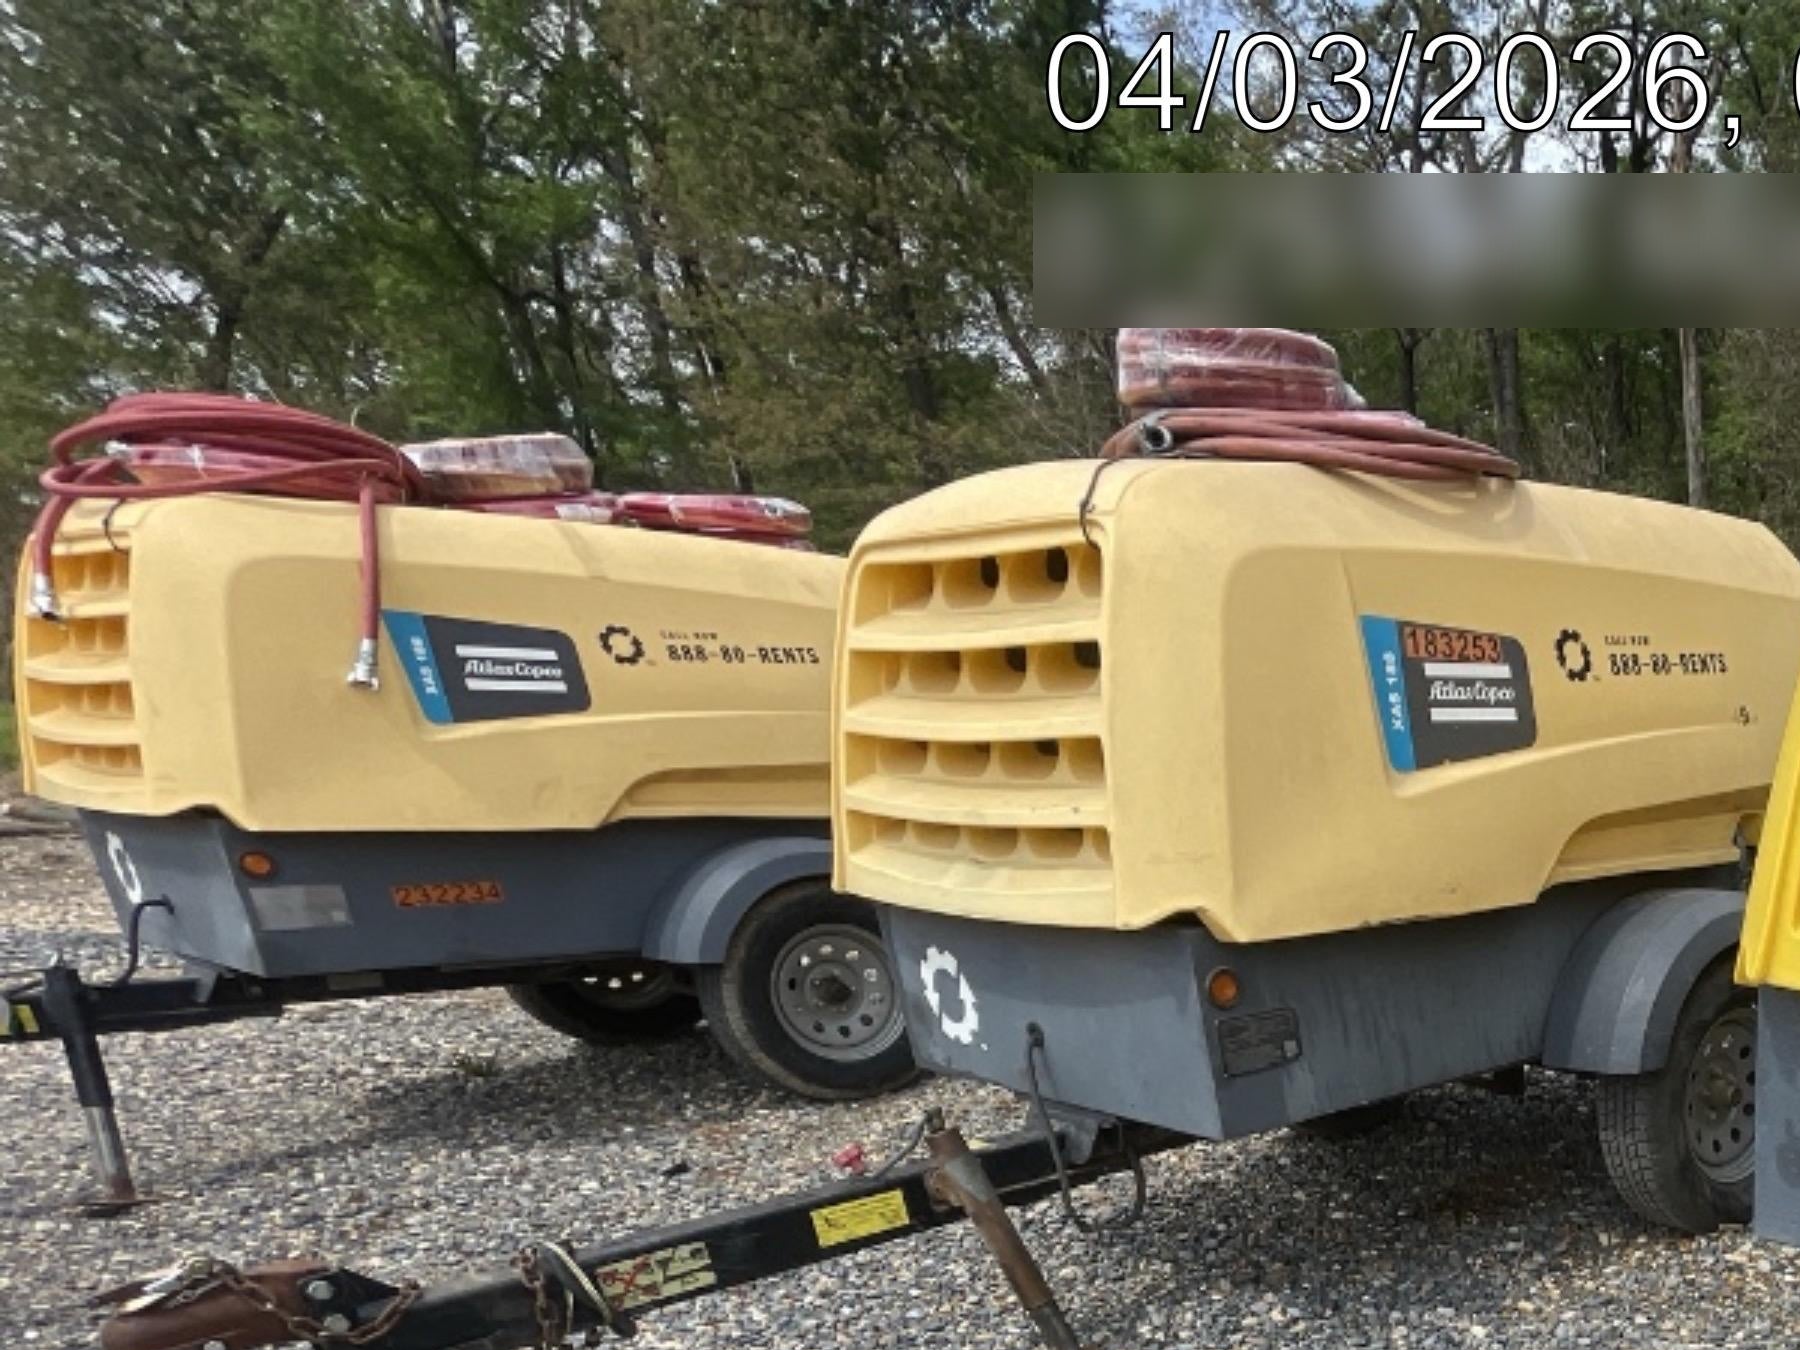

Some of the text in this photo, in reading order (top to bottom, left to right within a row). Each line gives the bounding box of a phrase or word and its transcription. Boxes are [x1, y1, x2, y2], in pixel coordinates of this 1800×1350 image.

[666, 643, 820, 665] 888-80-RENTS
[1407, 626, 1501, 663] 183253
[1608, 652, 1729, 676] 888-80-RENTS
[394, 880, 500, 907] 232234
